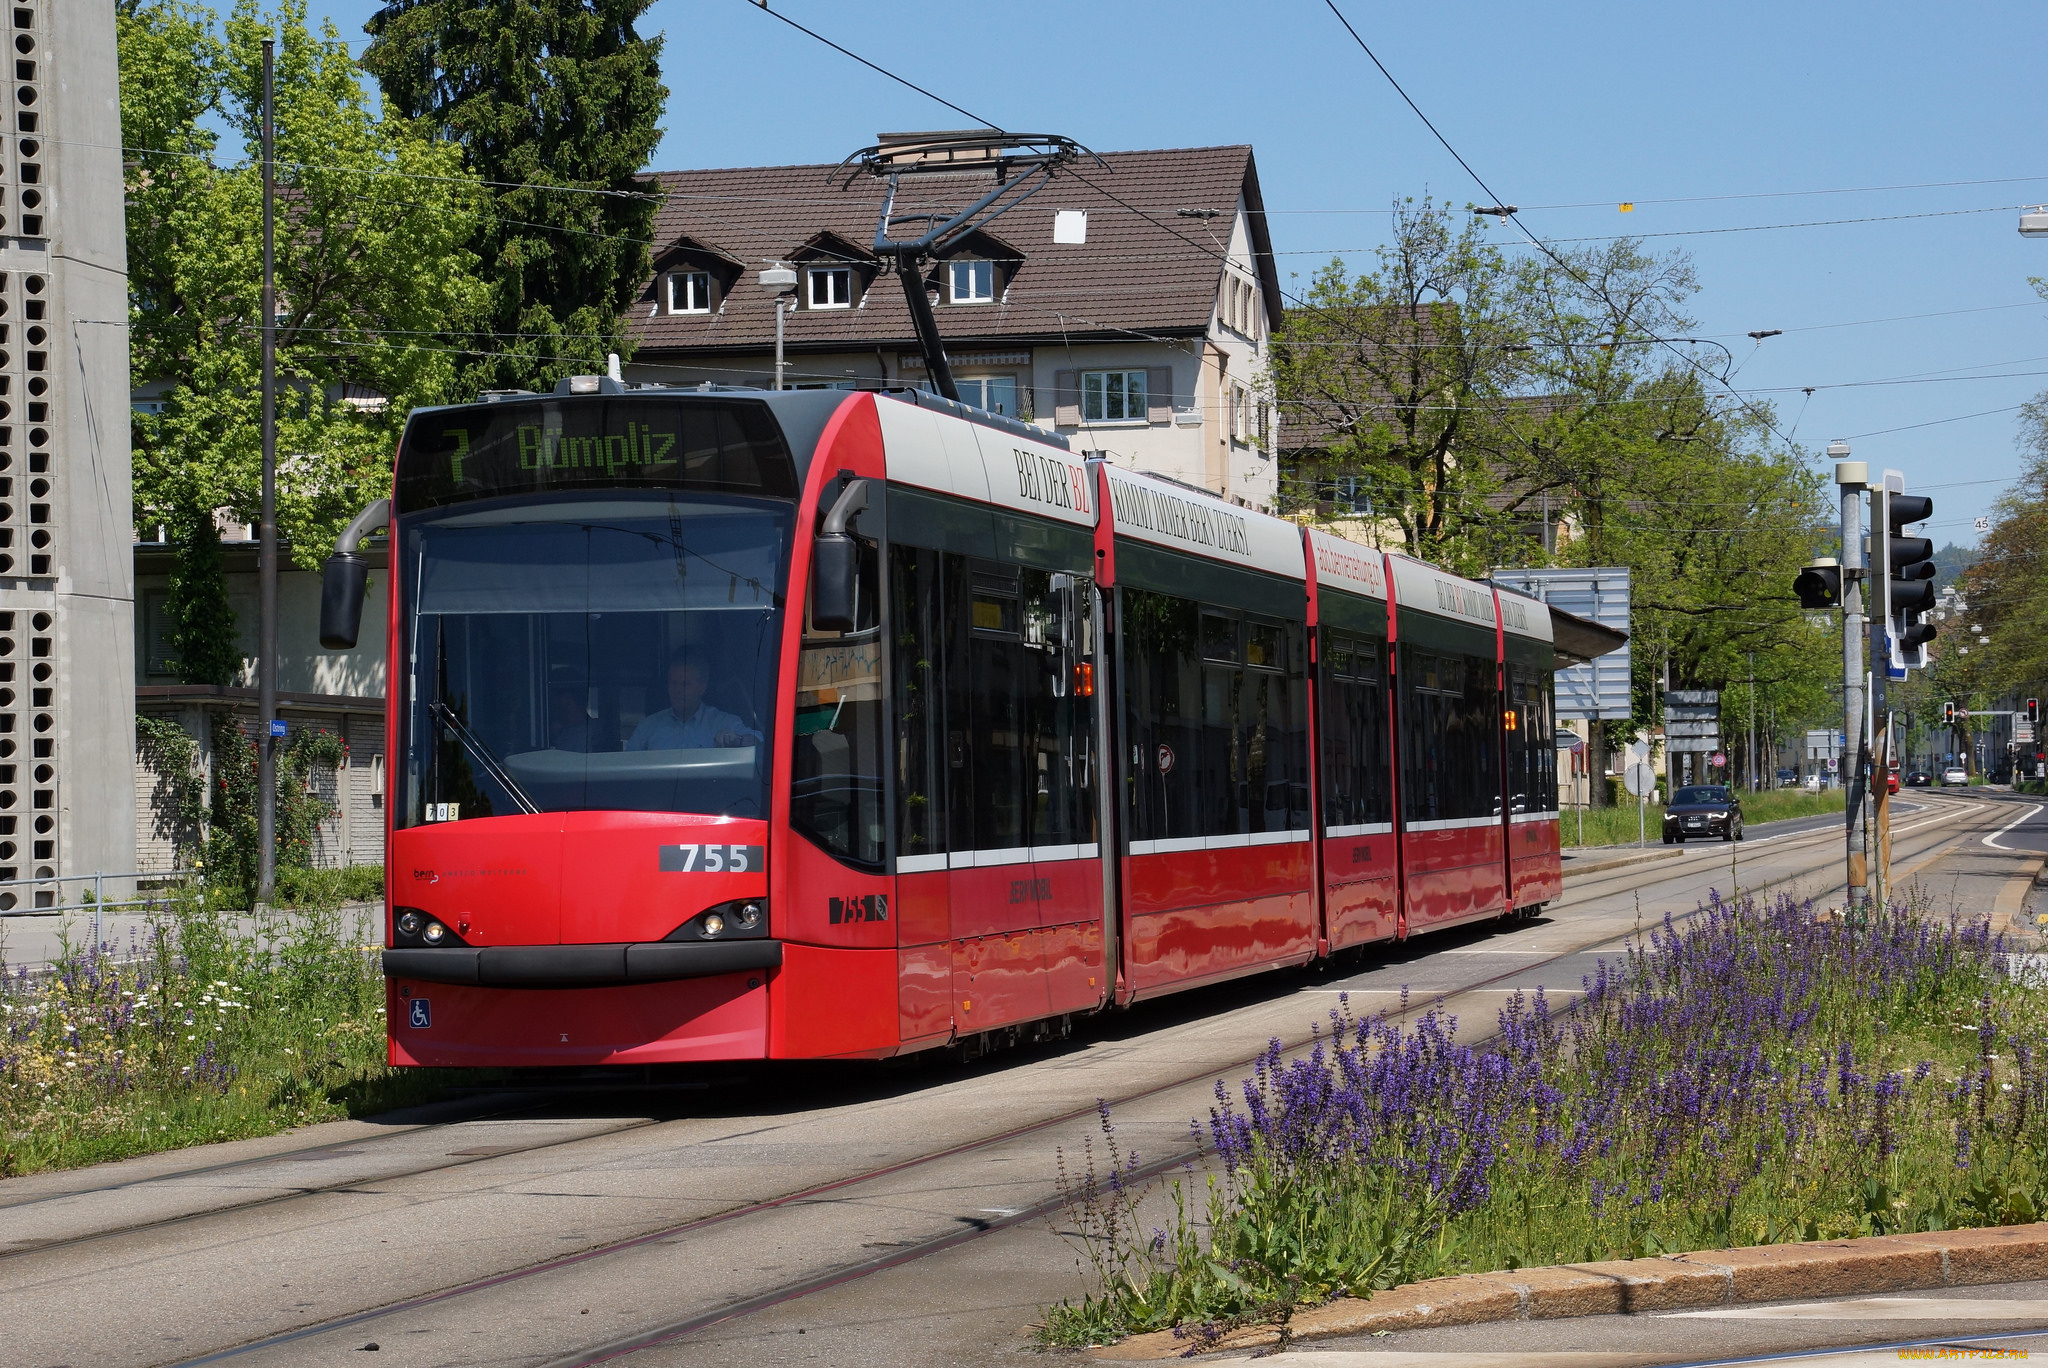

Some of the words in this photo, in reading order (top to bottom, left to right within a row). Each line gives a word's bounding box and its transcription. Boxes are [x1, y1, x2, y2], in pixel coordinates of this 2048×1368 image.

[442, 429, 469, 483] 7
[517, 421, 677, 477] Bümpliz
[1013, 448, 1042, 501] BEI
[1039, 456, 1072, 509] DER
[1068, 465, 1090, 514] BZ
[1151, 489, 1190, 540] IMMER
[1975, 519, 1989, 529] 45
[413, 868, 435, 878] bern
[679, 844, 748, 873] 755
[838, 896, 867, 923] 755
